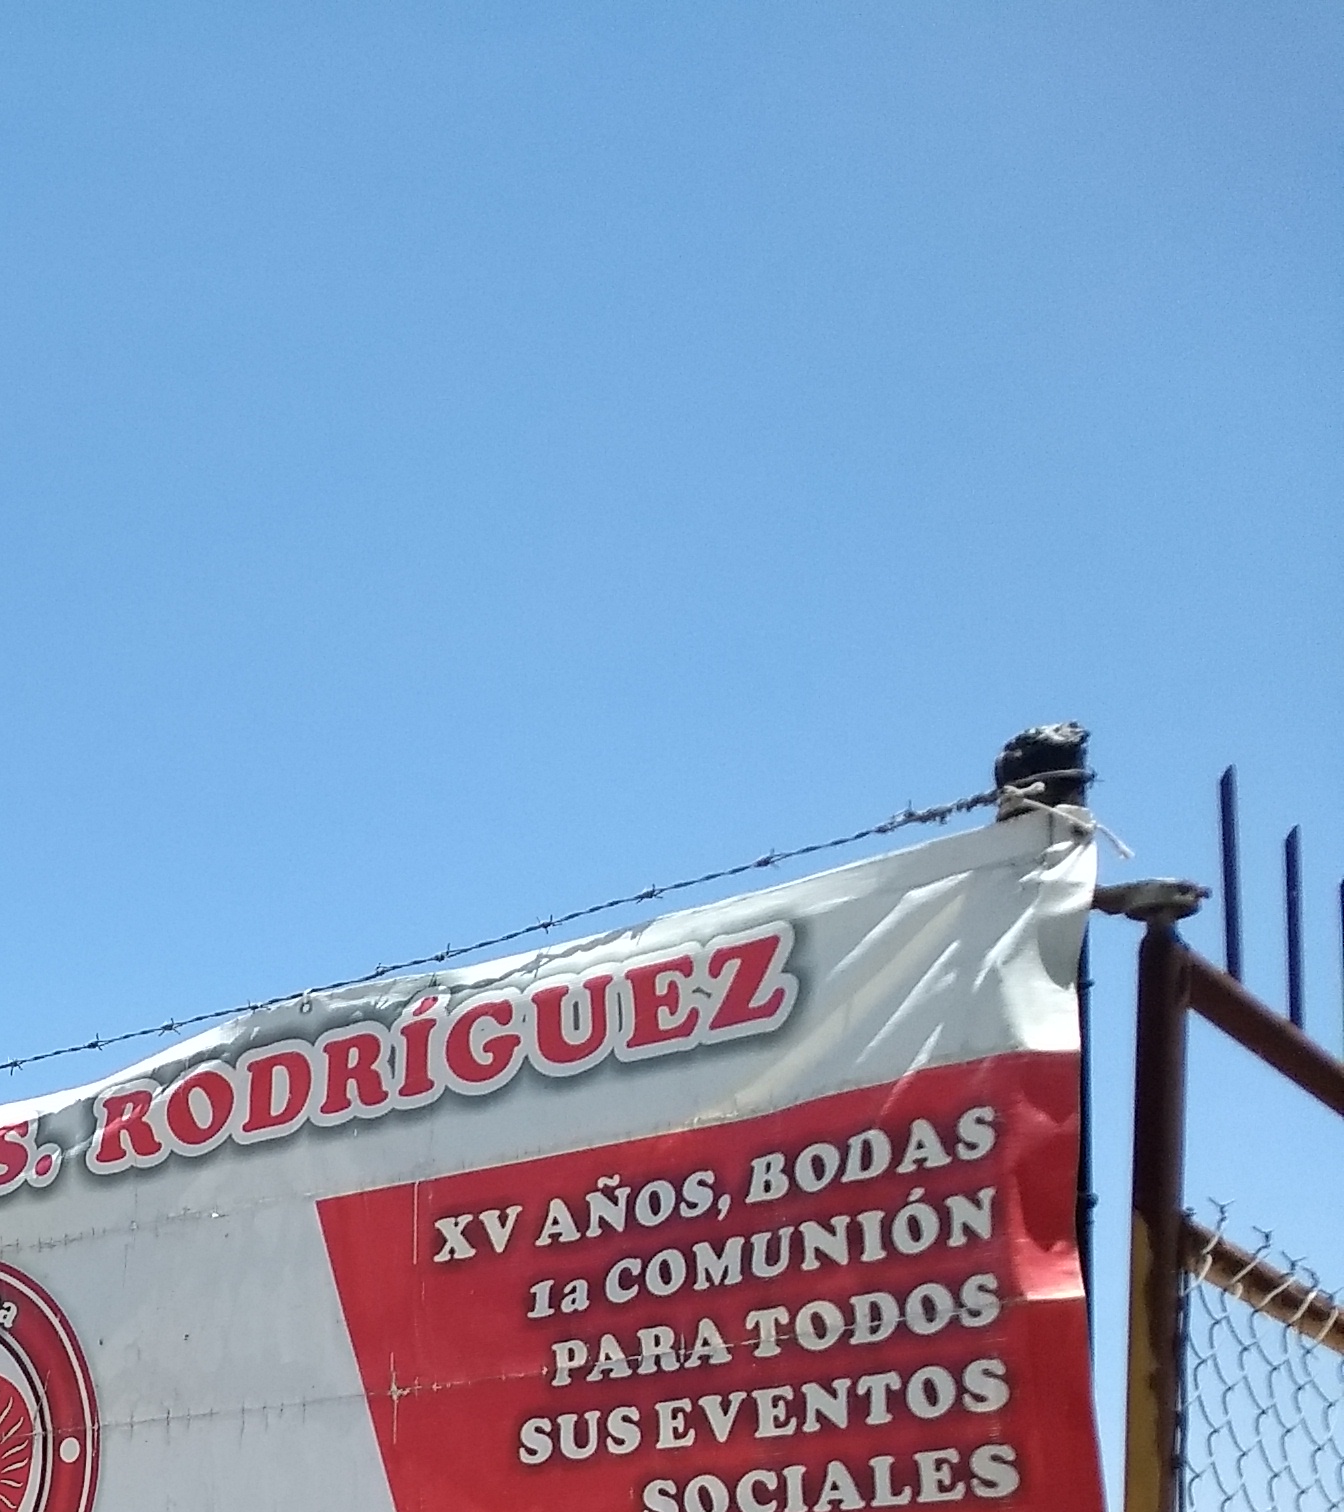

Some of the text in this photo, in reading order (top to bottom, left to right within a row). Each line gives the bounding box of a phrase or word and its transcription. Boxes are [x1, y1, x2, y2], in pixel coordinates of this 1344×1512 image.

[94, 932, 788, 1166] RODRÍGUEZ
[433, 1105, 997, 1263] XV AÑOS, BODAS
[526, 1185, 998, 1319] 1a COMUNIÓN
[549, 1272, 1001, 1387] PARA TODOS
[518, 1358, 1011, 1466] SUS EVENTOS
